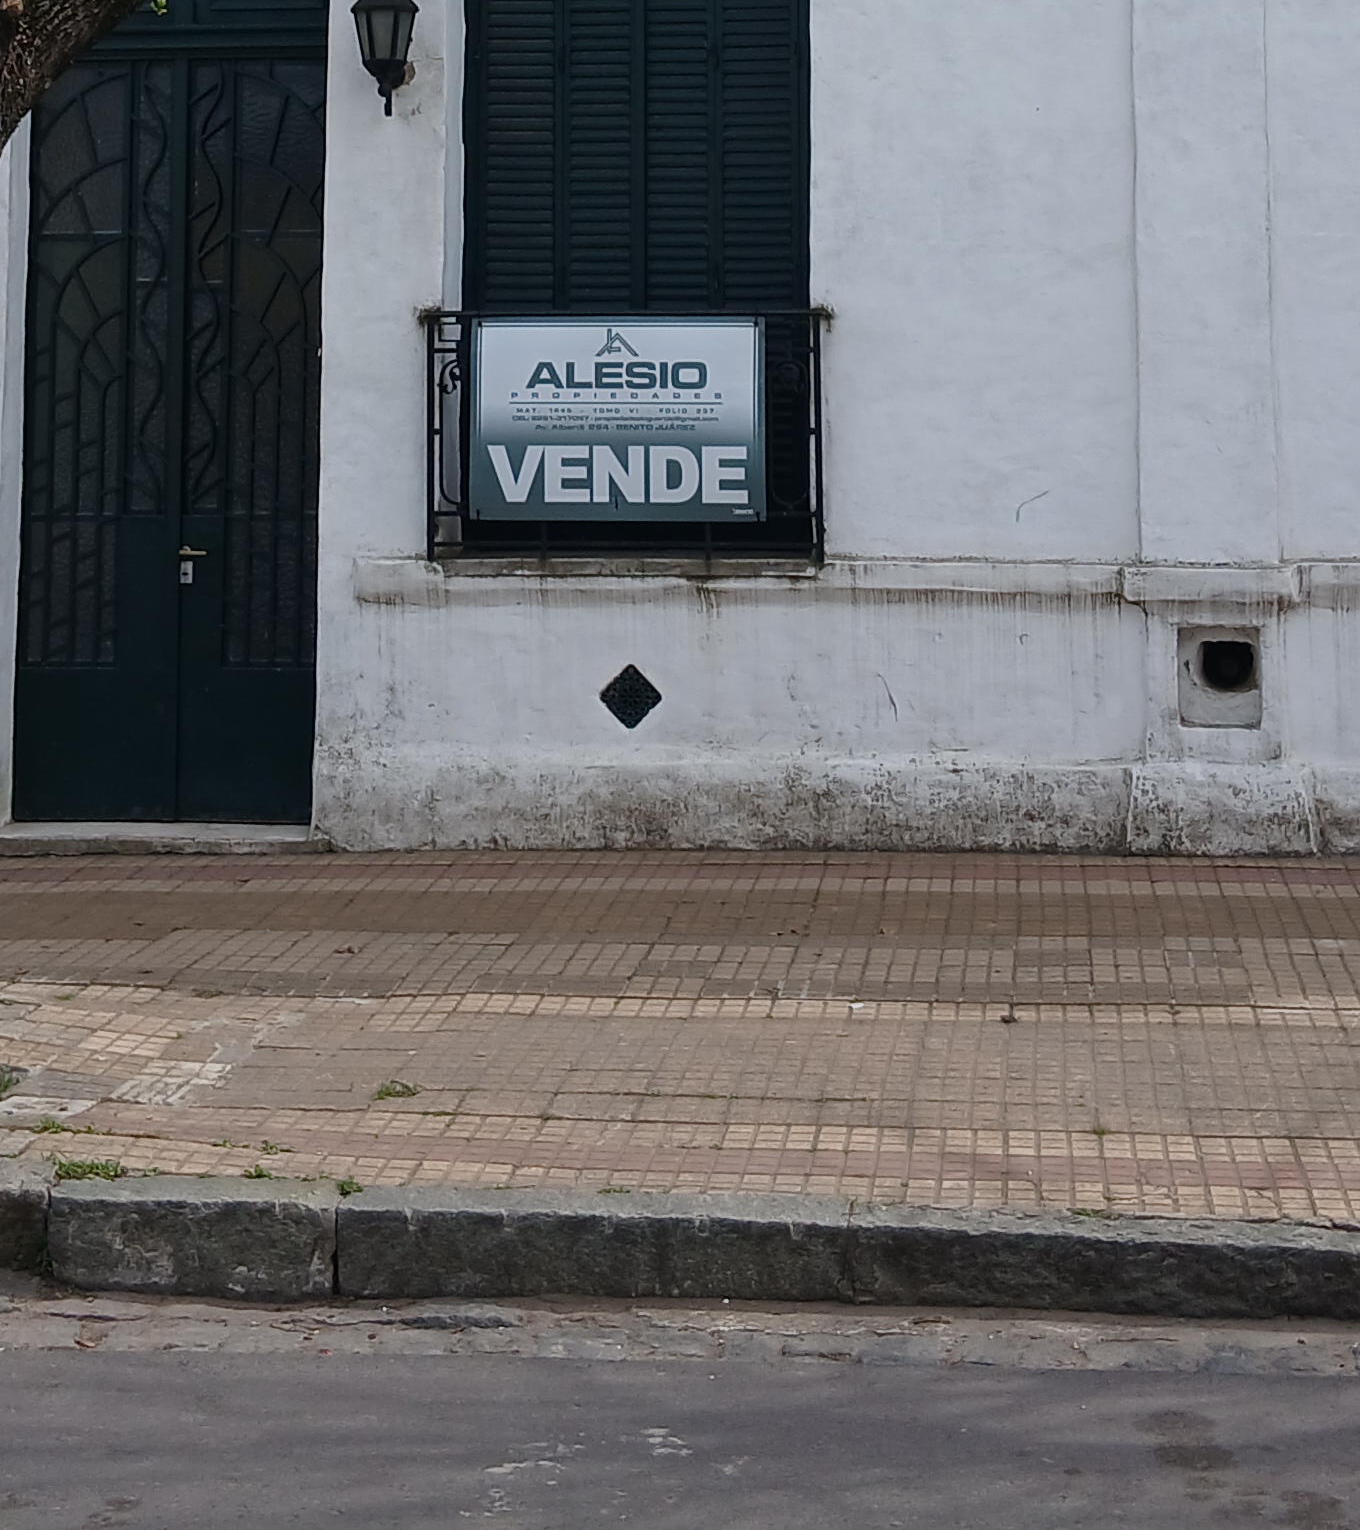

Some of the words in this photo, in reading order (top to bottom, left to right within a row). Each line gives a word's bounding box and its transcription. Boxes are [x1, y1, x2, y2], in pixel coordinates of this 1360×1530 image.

[525, 361, 708, 390] ALESIO
[510, 391, 722, 400] PROPIEDADES
[486, 444, 749, 504] VENDE
